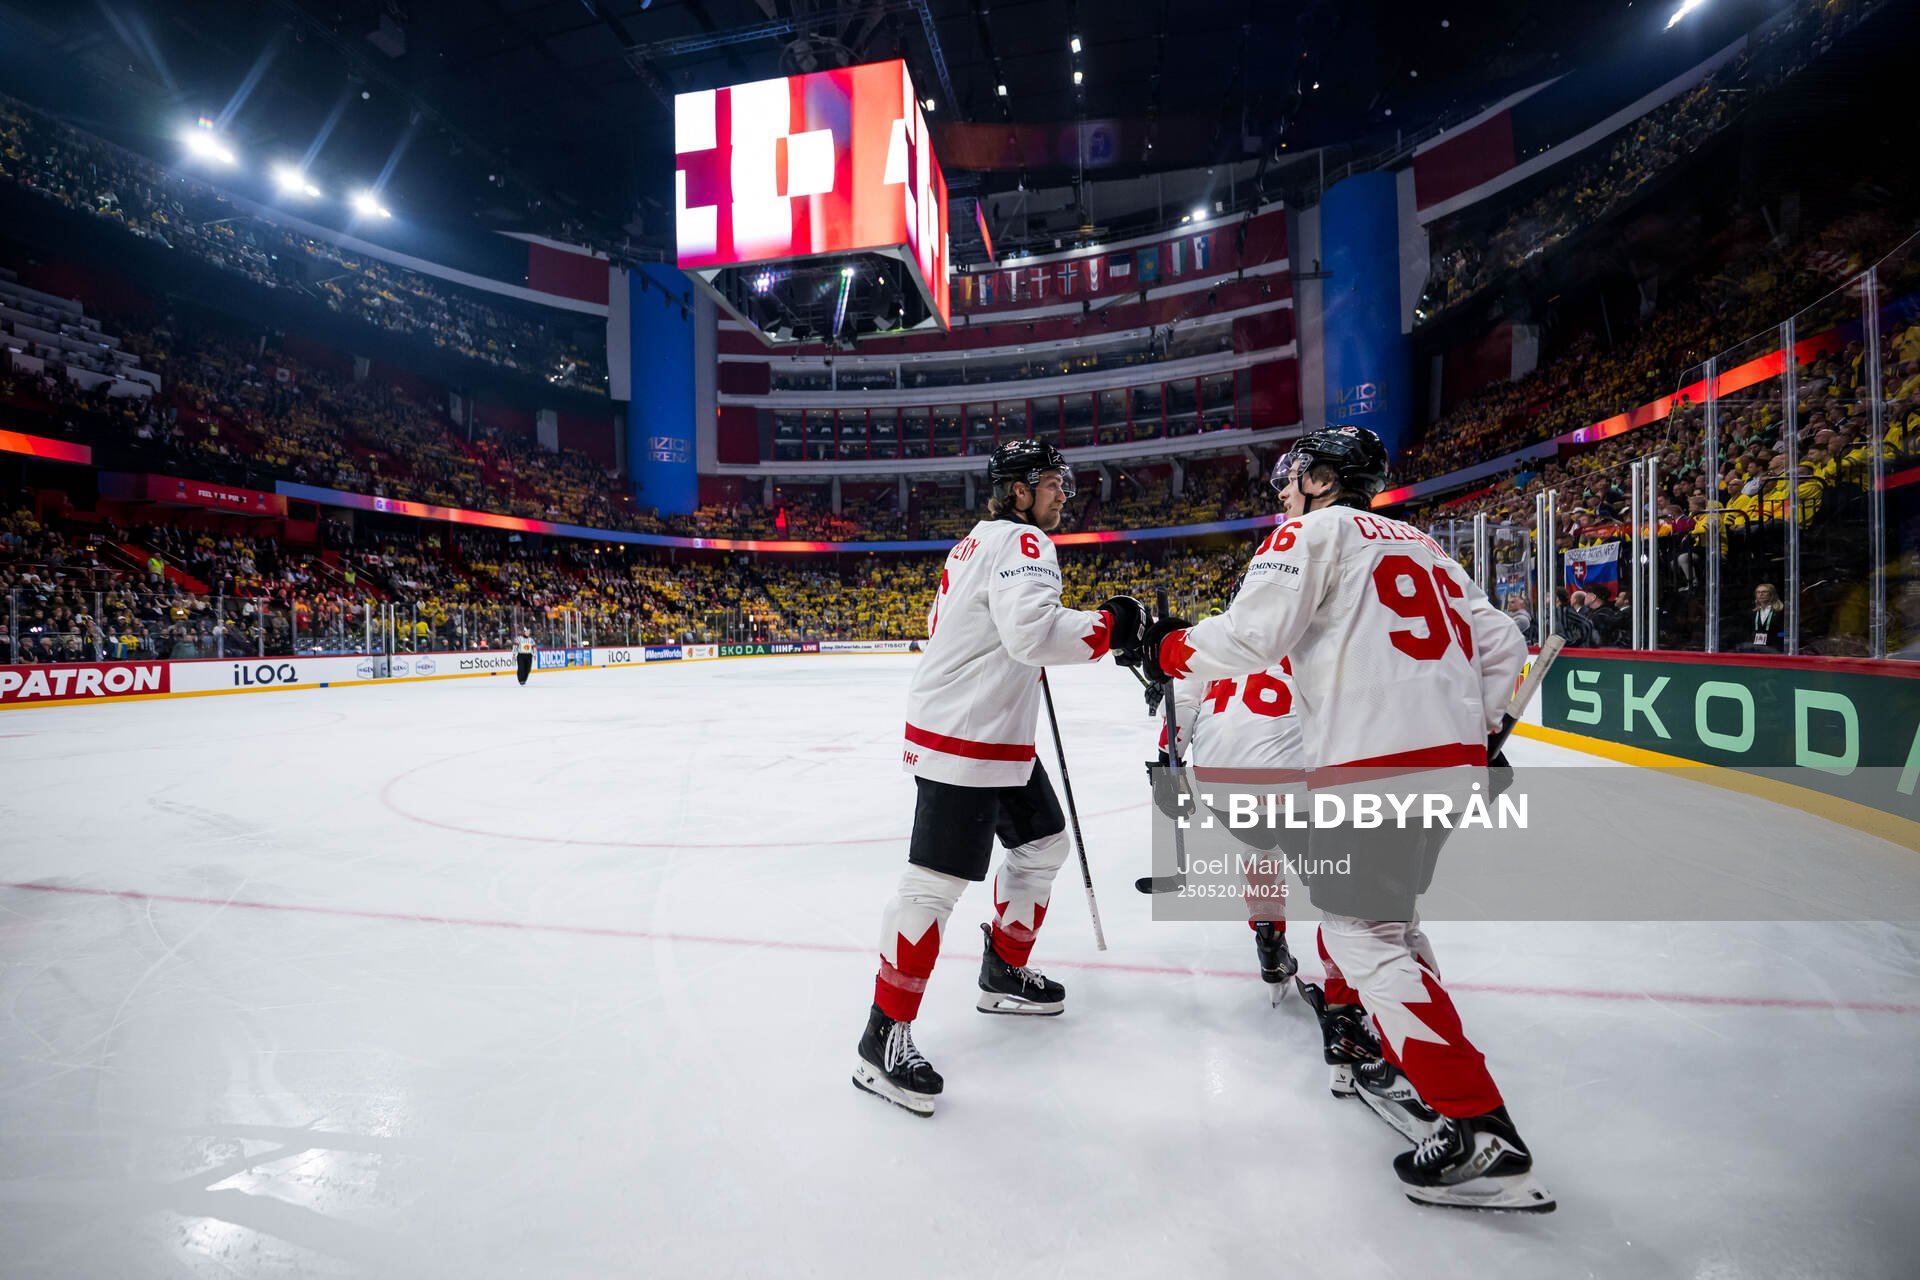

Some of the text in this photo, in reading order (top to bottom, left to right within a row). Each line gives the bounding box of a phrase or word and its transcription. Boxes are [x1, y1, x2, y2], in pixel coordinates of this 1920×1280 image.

[1020, 533, 1040, 559] 6
[1000, 565, 1060, 580] WESTMINSTER
[1373, 555, 1474, 663] 96
[539, 650, 566, 665] NOCCO
[802, 644, 817, 652] LIVE
[0, 665, 162, 699] PATRON
[234, 663, 298, 686] iLOQ
[1202, 654, 1293, 718] 46
[1386, 1088, 1411, 1099] CCM
